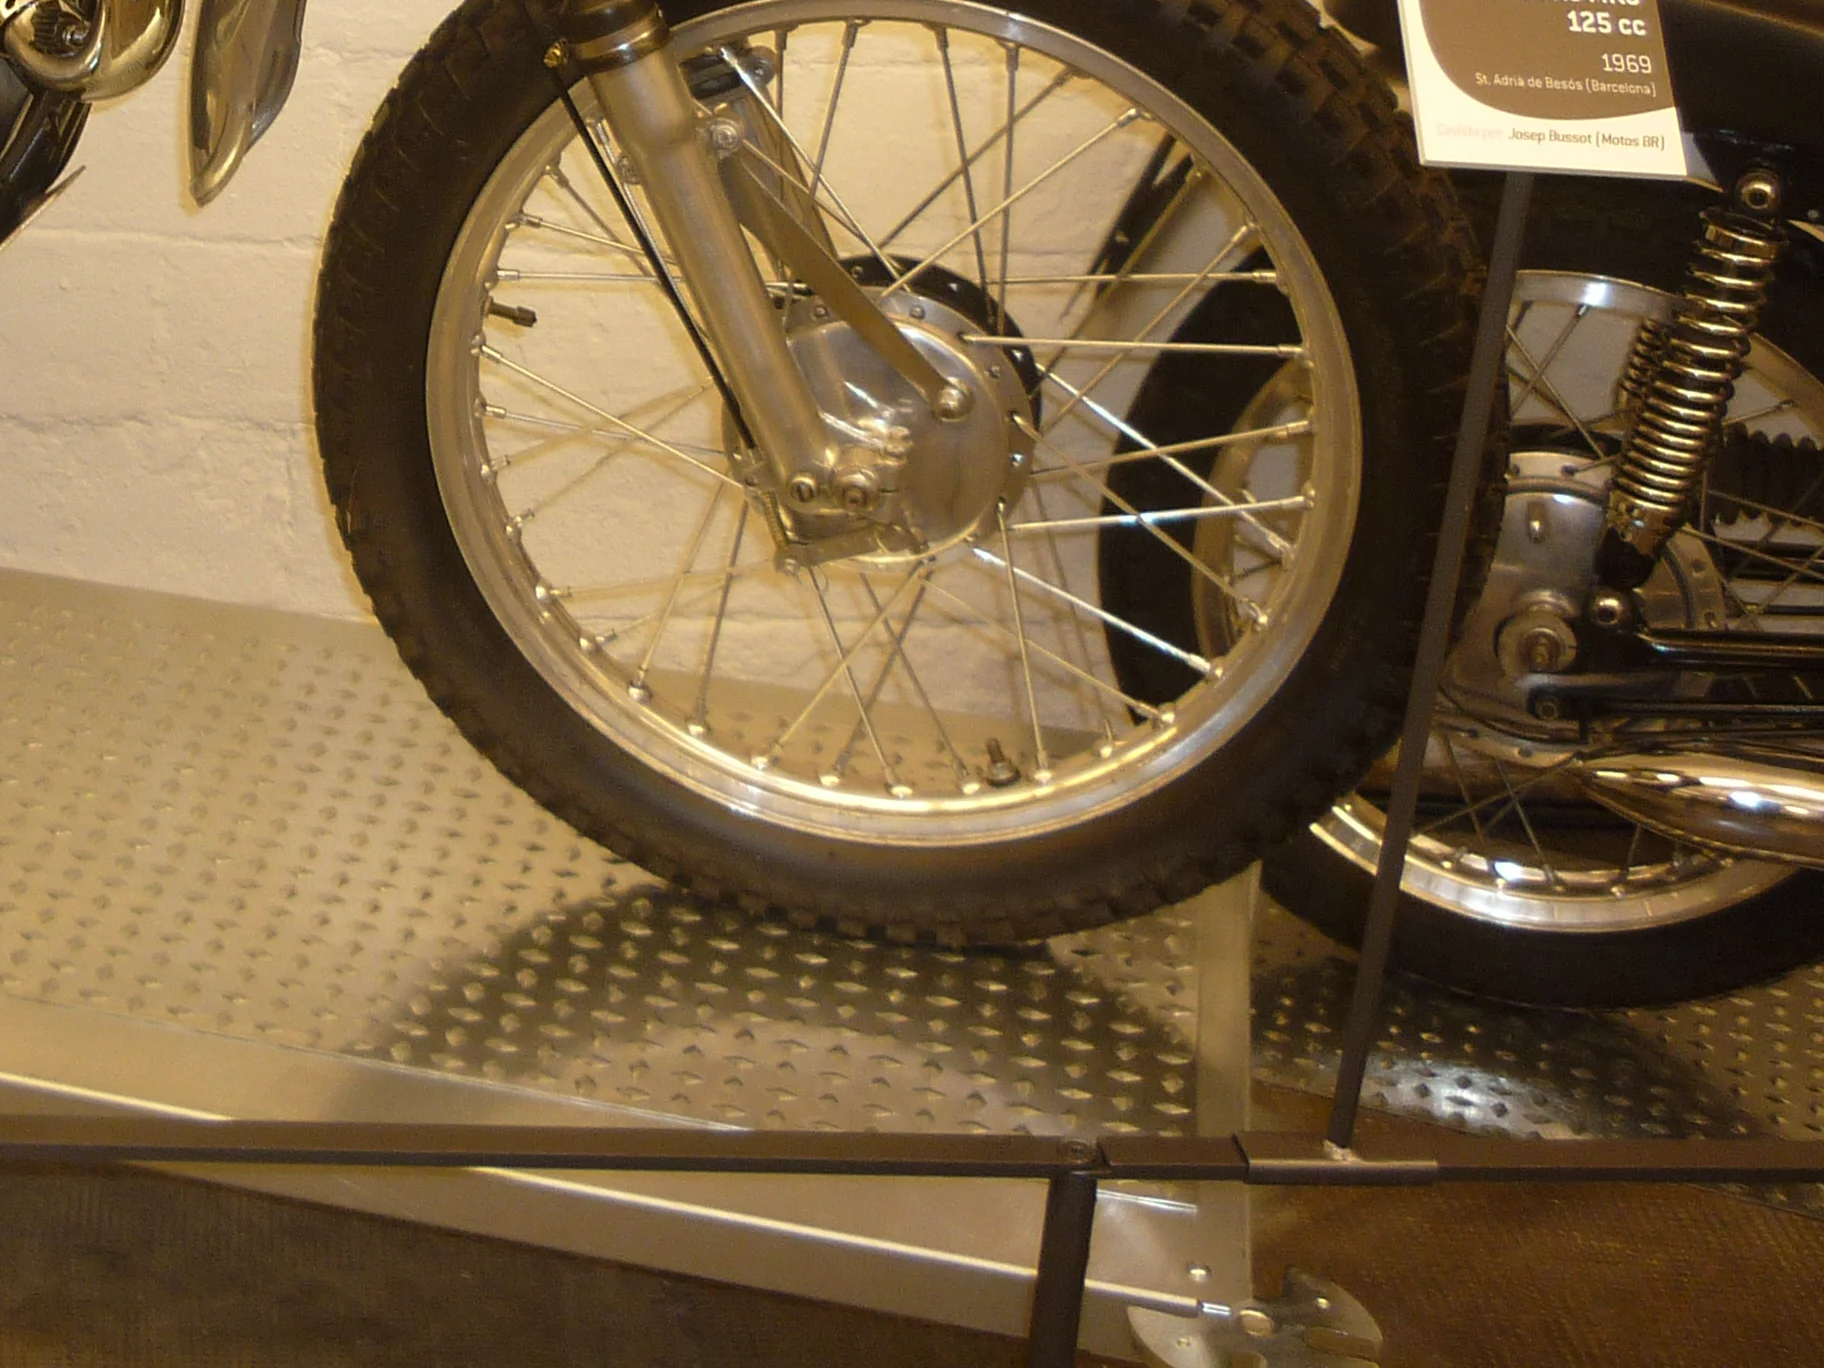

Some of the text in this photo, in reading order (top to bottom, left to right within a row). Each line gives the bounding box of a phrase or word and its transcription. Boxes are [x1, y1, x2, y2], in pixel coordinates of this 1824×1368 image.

[1567, 9, 1647, 36] 125 cc
[1601, 52, 1653, 75] 1969
[1527, 76, 1543, 89] de
[1585, 79, 1657, 98] (Barcelona)
[1507, 127, 1546, 144] Josep
[1548, 129, 1592, 145] Bussot
[1595, 130, 1637, 148] (Motos
[1642, 134, 1666, 151] BR)
